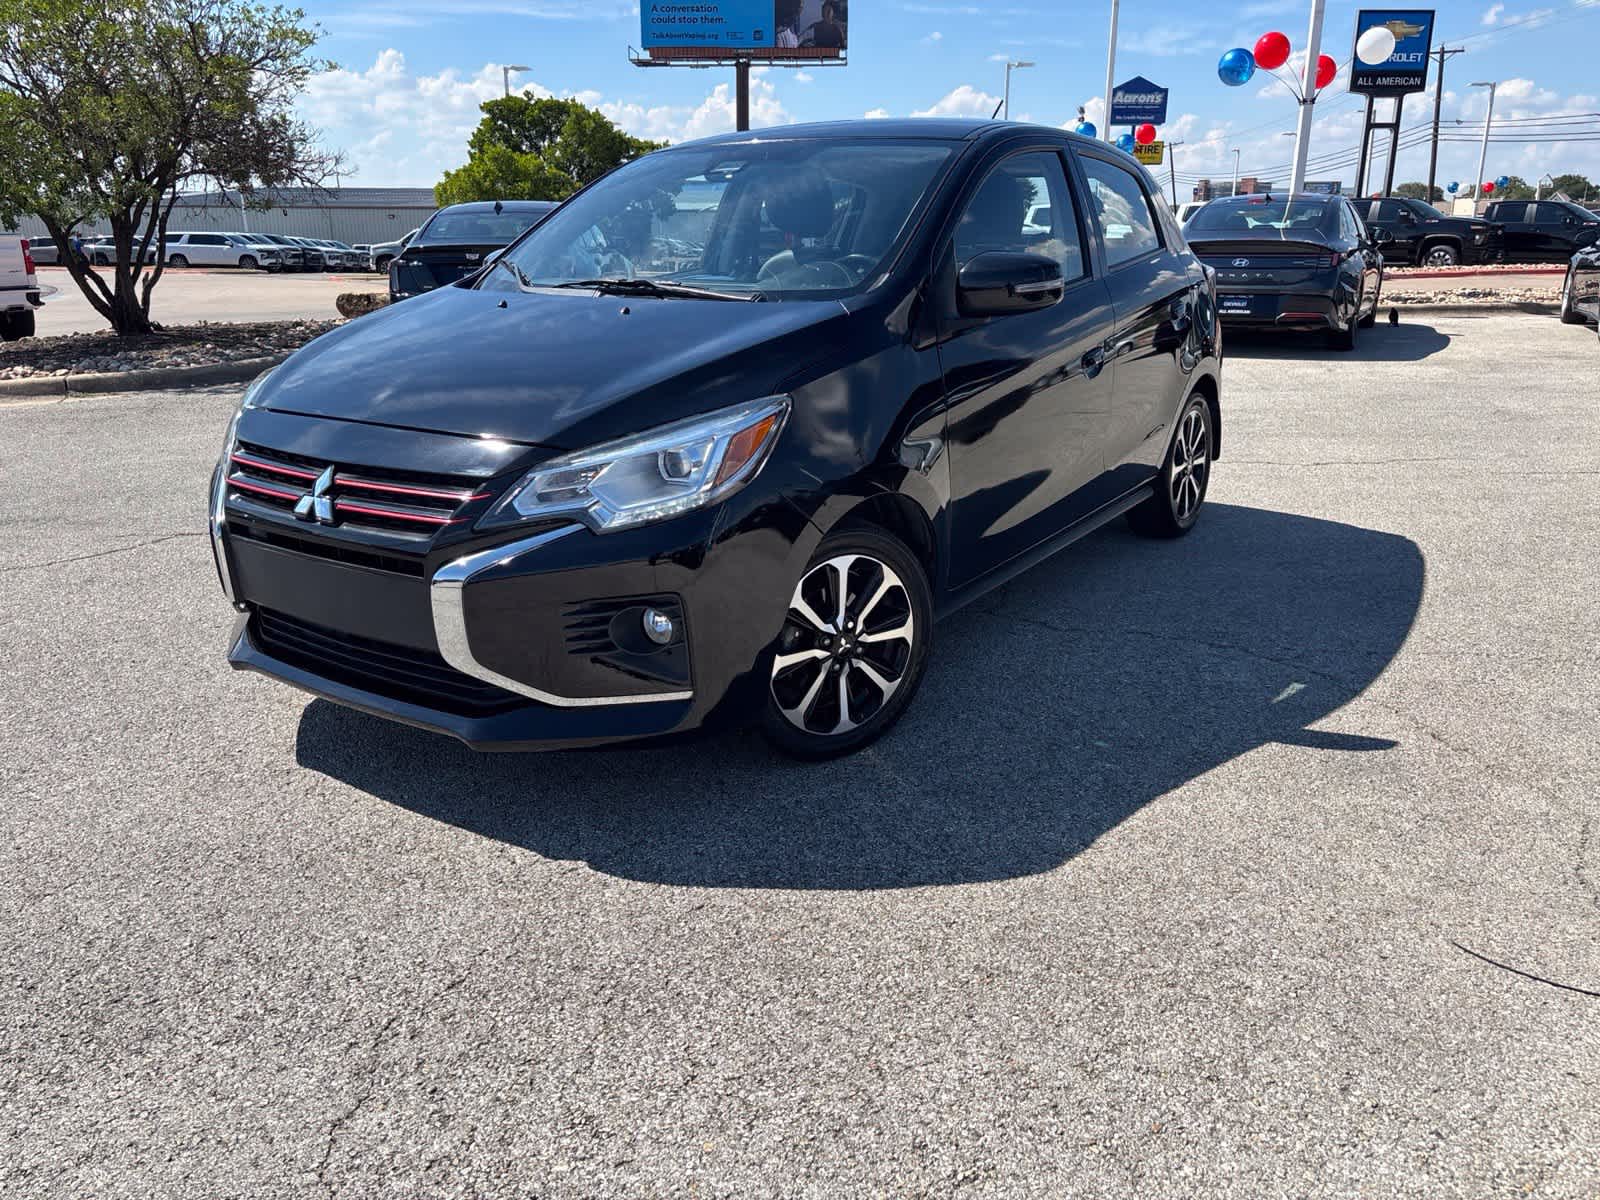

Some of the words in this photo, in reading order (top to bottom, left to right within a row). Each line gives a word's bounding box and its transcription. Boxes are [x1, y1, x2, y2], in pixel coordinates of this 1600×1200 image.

[651, 4, 658, 13] A
[660, 4, 719, 13] conversation
[651, 15, 676, 24] could
[678, 16, 698, 25] stop
[701, 15, 727, 24] them.
[1357, 77, 1373, 86] ALL
[1376, 76, 1421, 86] AMERICAN
